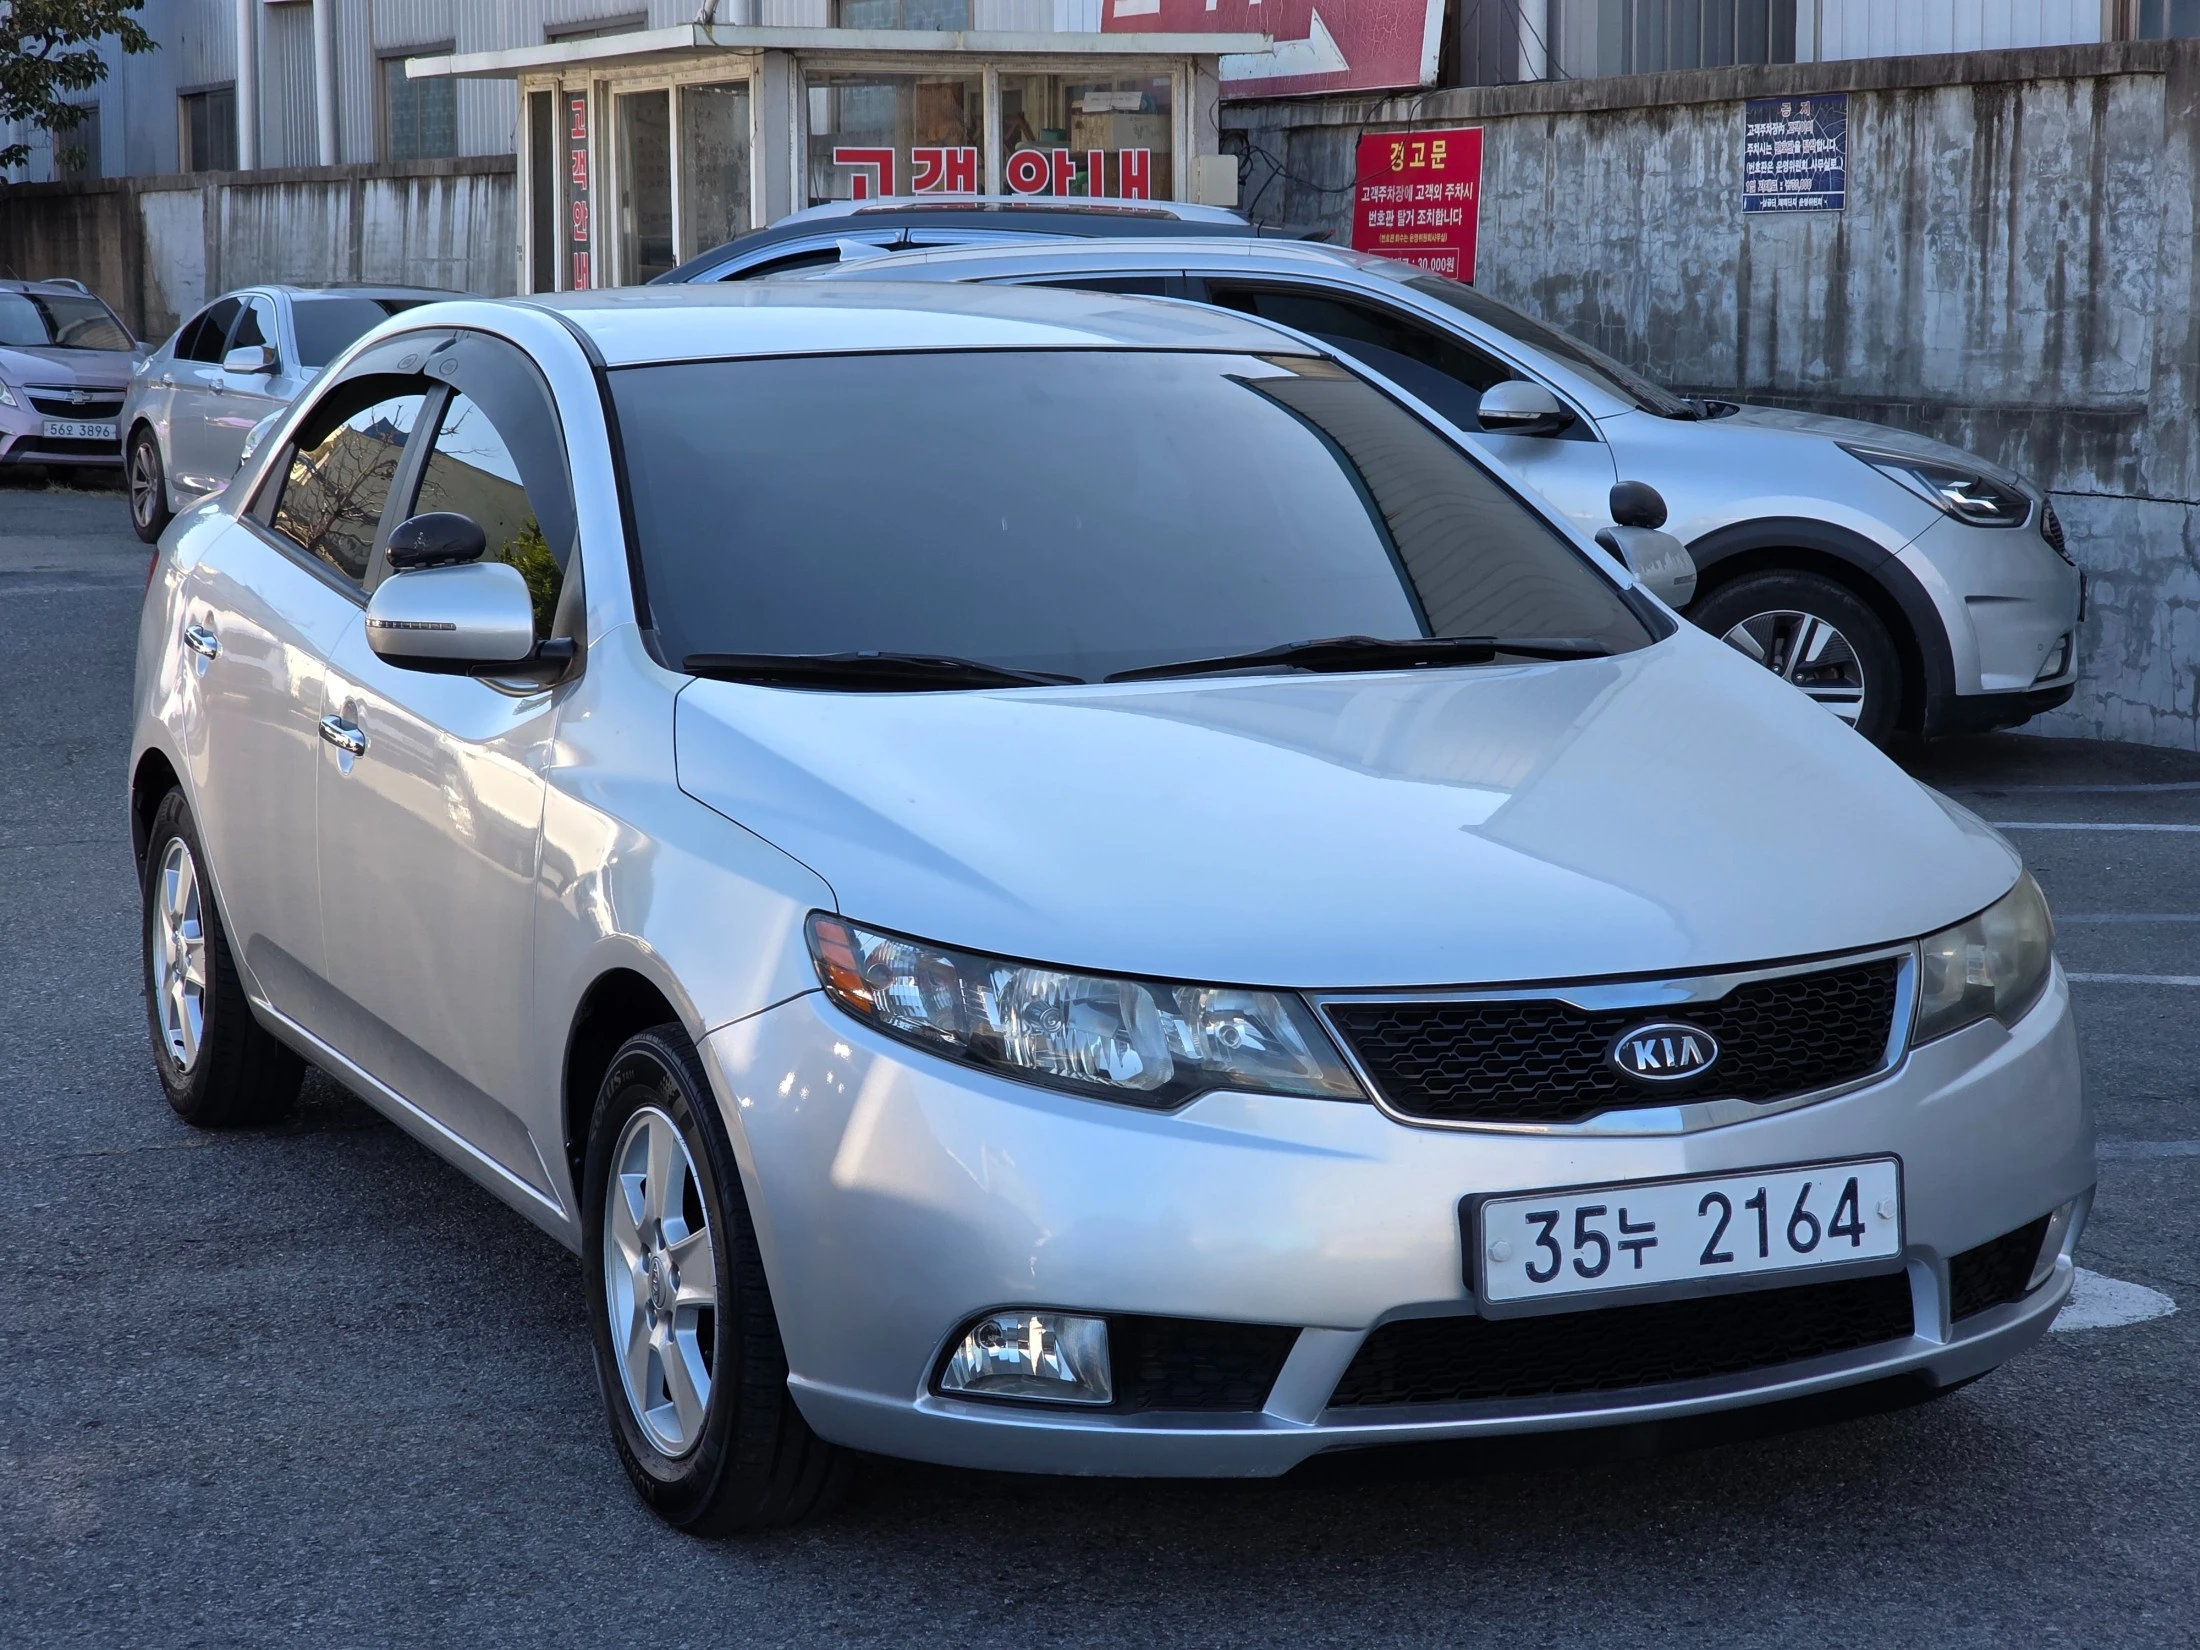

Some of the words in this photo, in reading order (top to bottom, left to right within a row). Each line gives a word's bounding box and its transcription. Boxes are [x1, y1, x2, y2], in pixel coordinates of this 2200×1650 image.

[1390, 140, 1447, 171] 경고문
[1747, 142, 1773, 156] 주차시는
[1776, 159, 1808, 173] 운영위원회
[1361, 184, 1413, 203] 고객주차장에
[1415, 183, 1442, 202] 고객외
[1445, 182, 1473, 201] 주차시
[1368, 209, 1394, 227] 번호판
[1397, 208, 1414, 227] 탈거
[1417, 207, 1462, 227] 조치합니다
[50, 423, 74, 436] 56오
[79, 425, 110, 437] 3896
[1632, 1036, 1705, 1070] KIA
[1525, 1204, 1658, 1284] 35누
[1698, 1176, 1866, 1266] 2164
